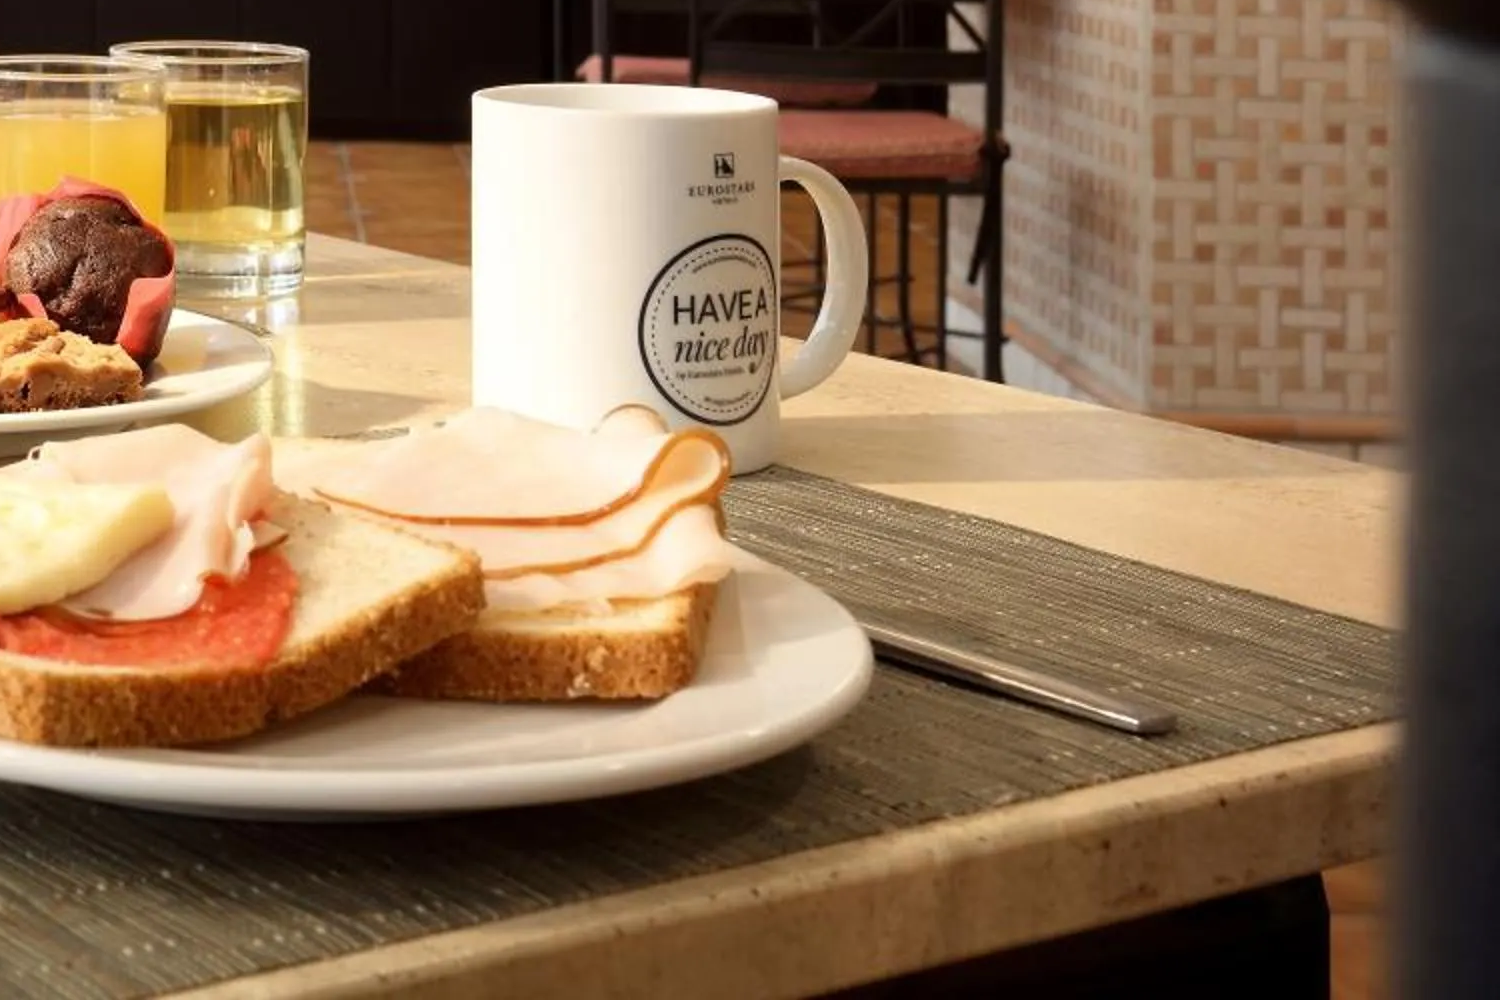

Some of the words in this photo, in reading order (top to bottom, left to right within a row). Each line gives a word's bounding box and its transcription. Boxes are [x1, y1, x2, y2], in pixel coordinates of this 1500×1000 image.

[673, 289, 753, 326] HAVE
[755, 287, 769, 319] A
[674, 331, 729, 363] nice
[732, 325, 769, 374] day
